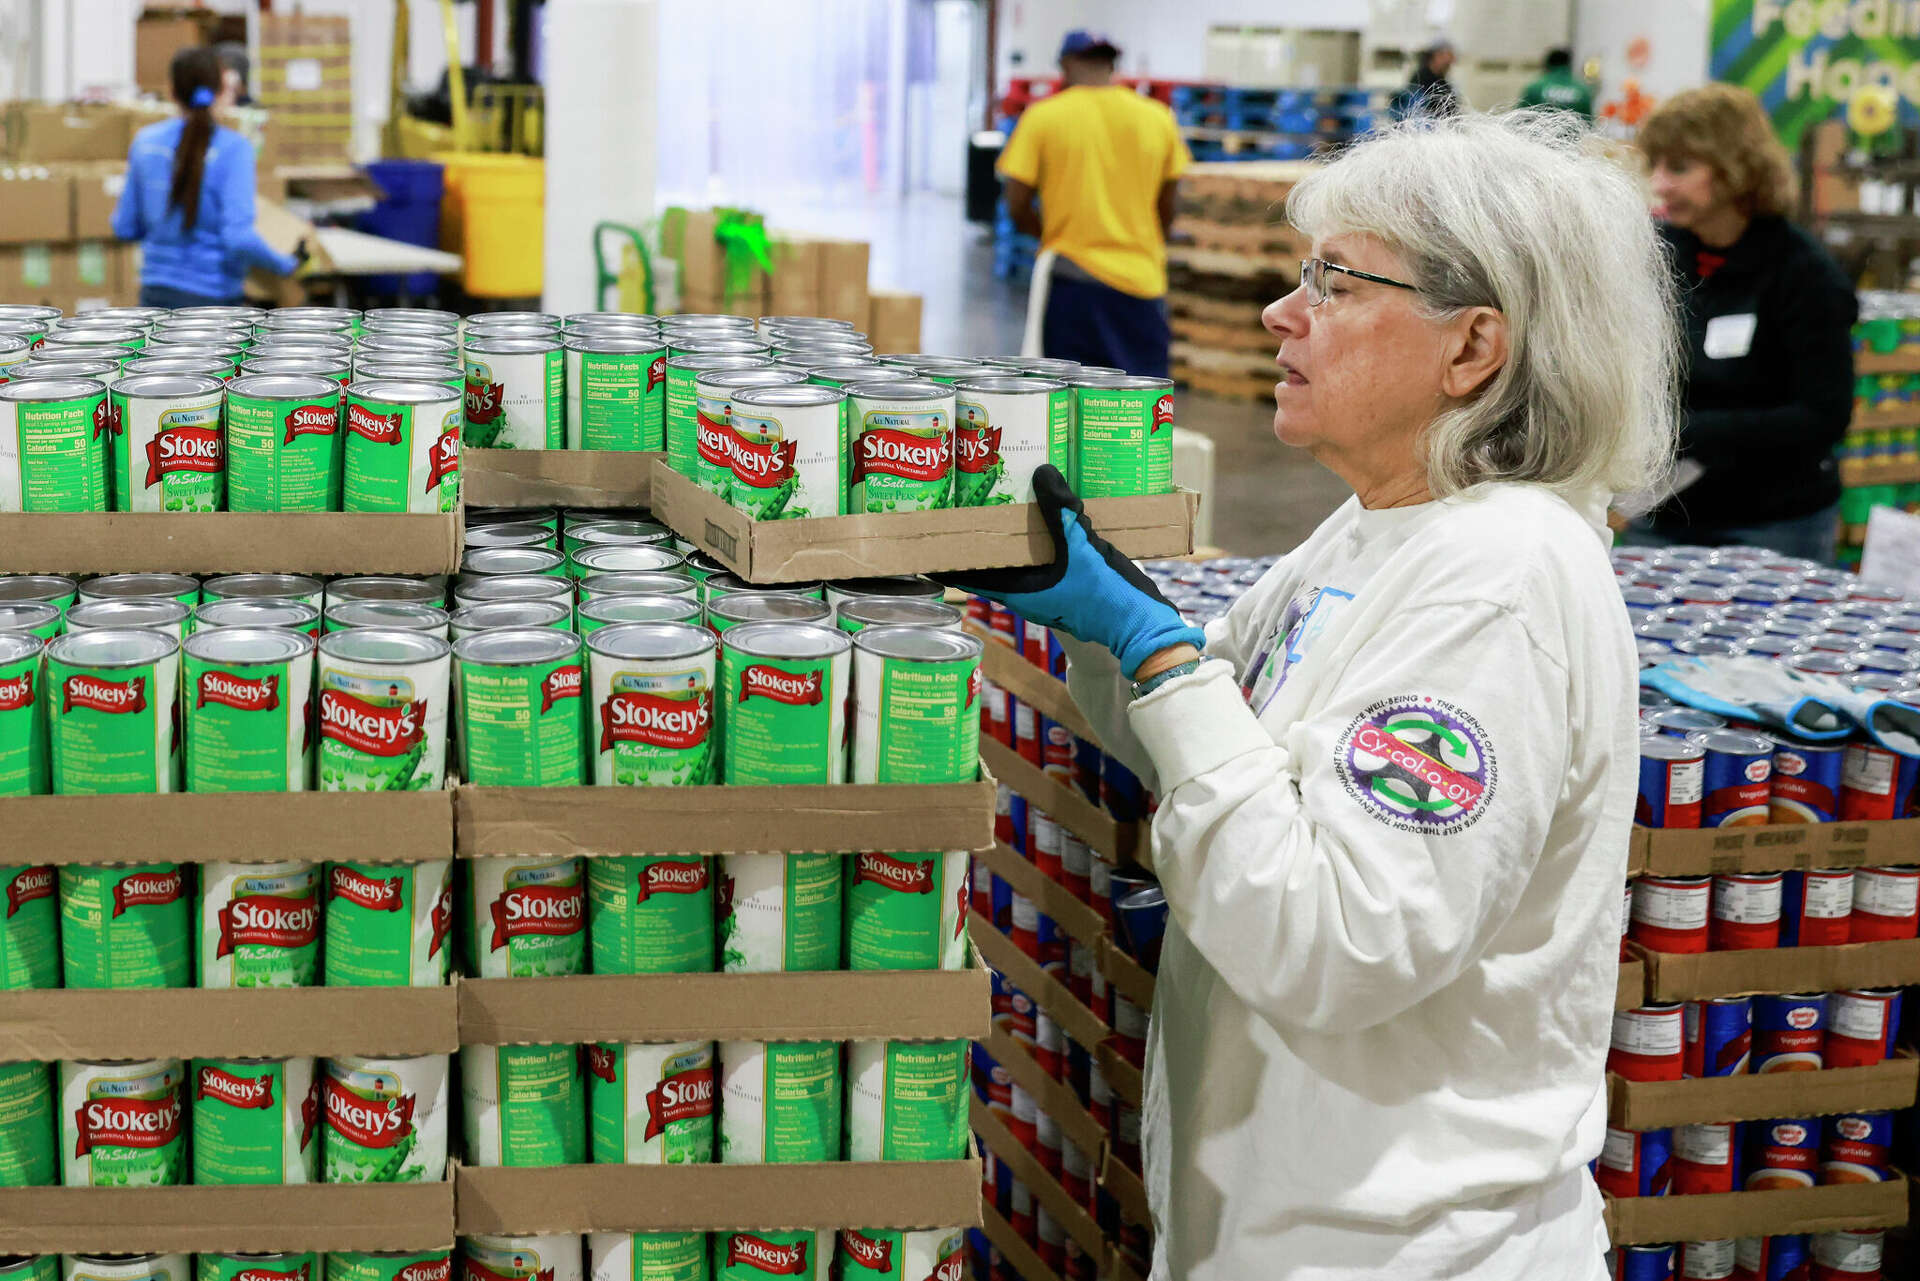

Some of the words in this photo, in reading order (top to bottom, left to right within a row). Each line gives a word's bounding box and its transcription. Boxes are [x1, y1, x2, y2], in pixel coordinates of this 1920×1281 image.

[628, 389, 639, 398] 50
[1130, 429, 1143, 439] 50
[74, 438, 86, 448] 50
[261, 440, 274, 448] 50
[1365, 694, 1419, 715] WELL-BEING
[1436, 698, 1455, 712] THE
[516, 710, 530, 721] 50
[944, 706, 957, 717] 50
[1338, 712, 1366, 746] ENHANCE
[1454, 707, 1488, 739] SCIENCE
[1334, 745, 1344, 755] TO
[1484, 740, 1494, 753] OF
[1334, 756, 1374, 814] ENVIRONMENT
[1484, 755, 1498, 806] PROPELLING
[1374, 812, 1390, 826] THE
[1464, 806, 1486, 828] ONE'S
[1392, 822, 1441, 836] THROUGH
[1442, 824, 1463, 836] SELF
[613, 894, 627, 906] 50
